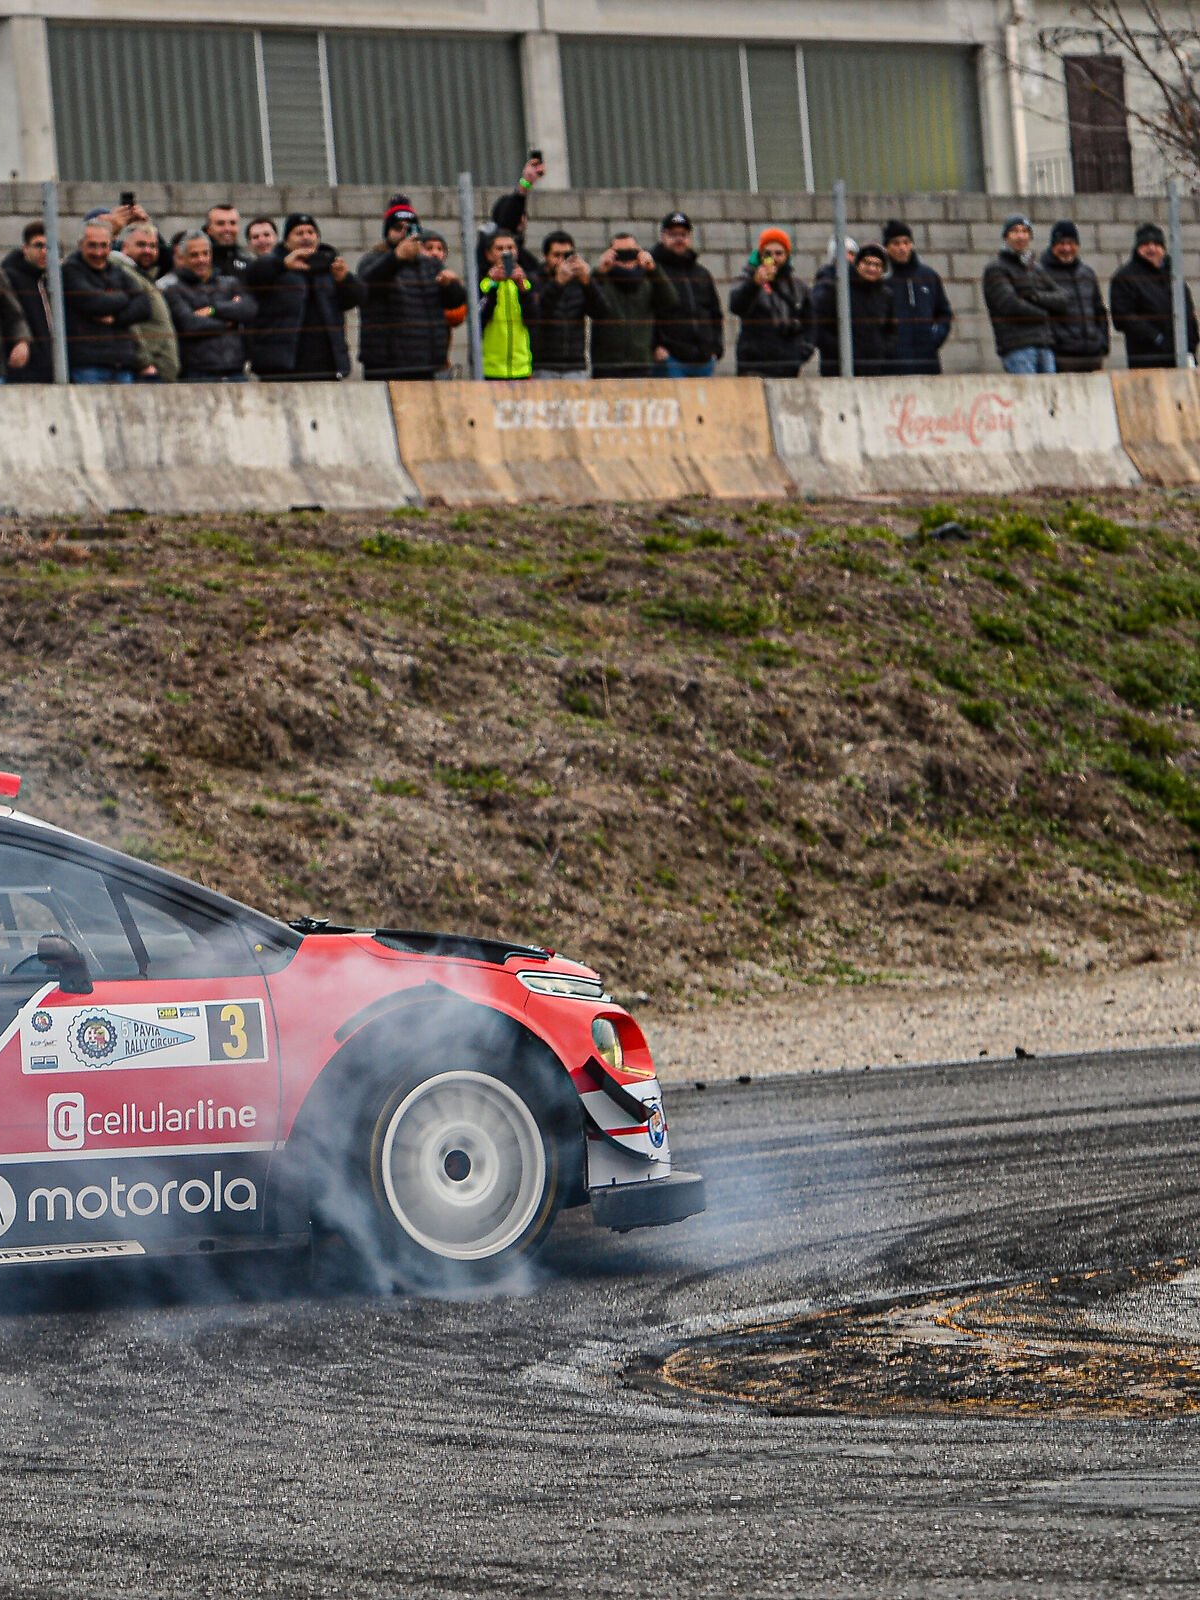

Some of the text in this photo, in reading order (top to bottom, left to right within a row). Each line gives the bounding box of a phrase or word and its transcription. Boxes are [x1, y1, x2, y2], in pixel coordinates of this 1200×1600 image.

[125, 1036, 180, 1056] RALLY CIRCUIT
[133, 1022, 161, 1038] PAVIA
[220, 1004, 248, 1059] 3
[87, 1099, 257, 1136] cellularline
[28, 1170, 257, 1222] motorola
